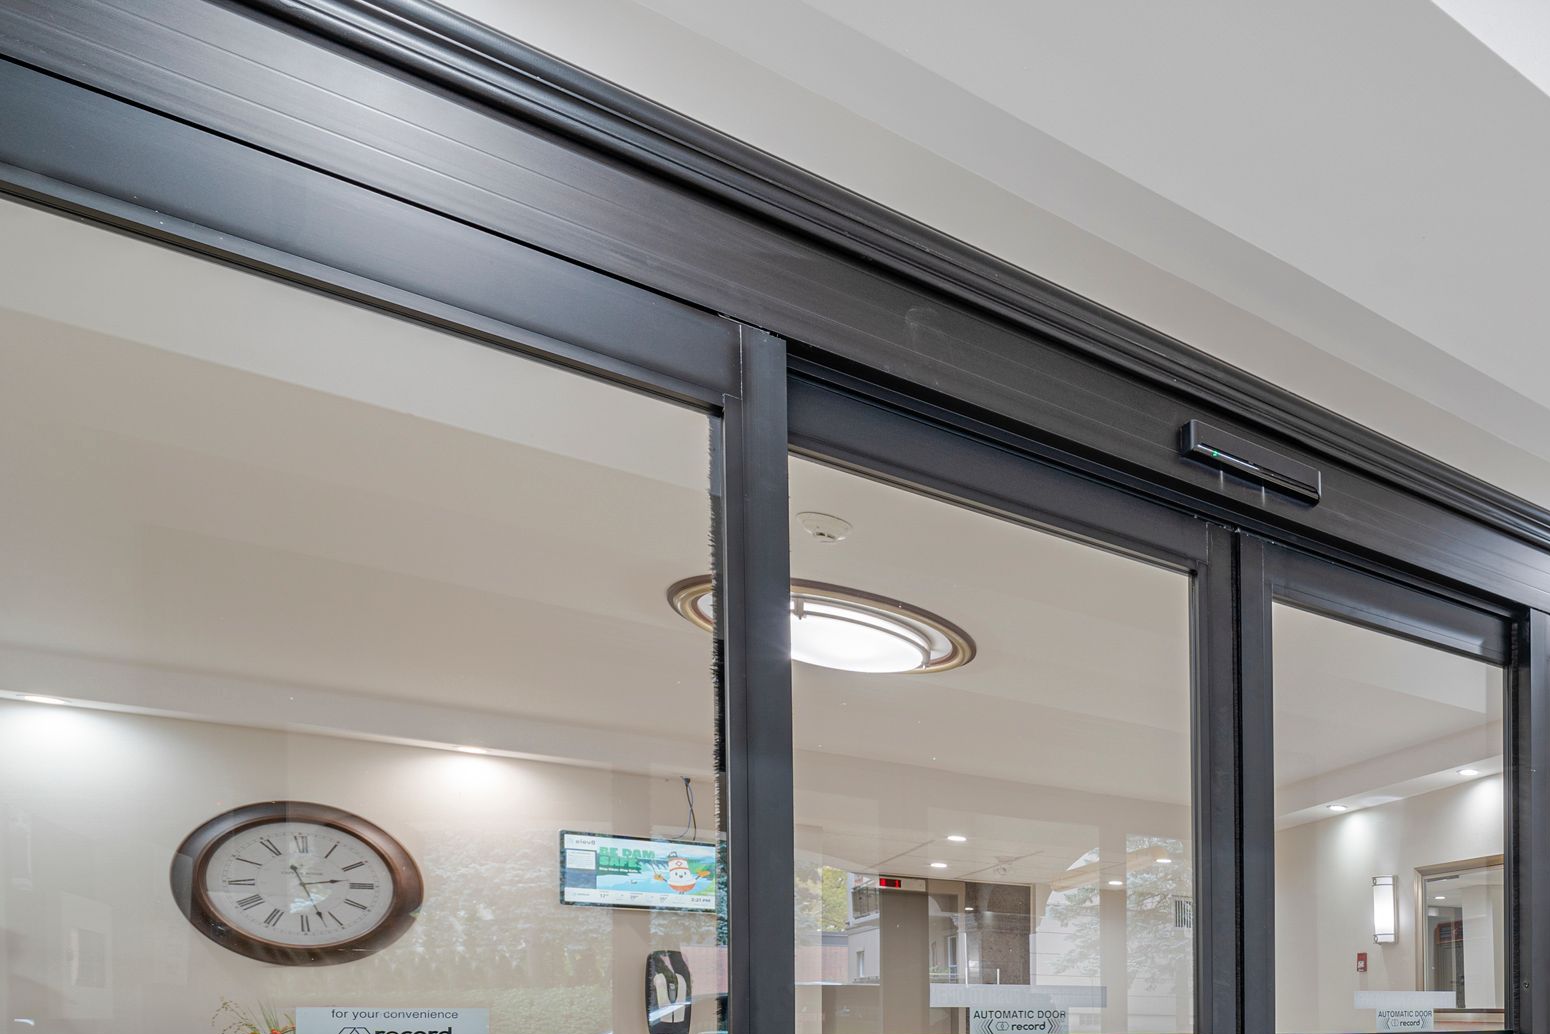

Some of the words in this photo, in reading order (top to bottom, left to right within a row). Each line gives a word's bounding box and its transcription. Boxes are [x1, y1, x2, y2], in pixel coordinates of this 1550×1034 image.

[599, 847, 618, 857] BE
[622, 848, 655, 859] DAM
[331, 1009, 349, 1019] for
[352, 1010, 379, 1020] your
[383, 1010, 459, 1019] convenience
[973, 1010, 1034, 1019] AUTOMATIC
[1037, 1010, 1066, 1019] DOOR
[1011, 1022, 1046, 1031] record
